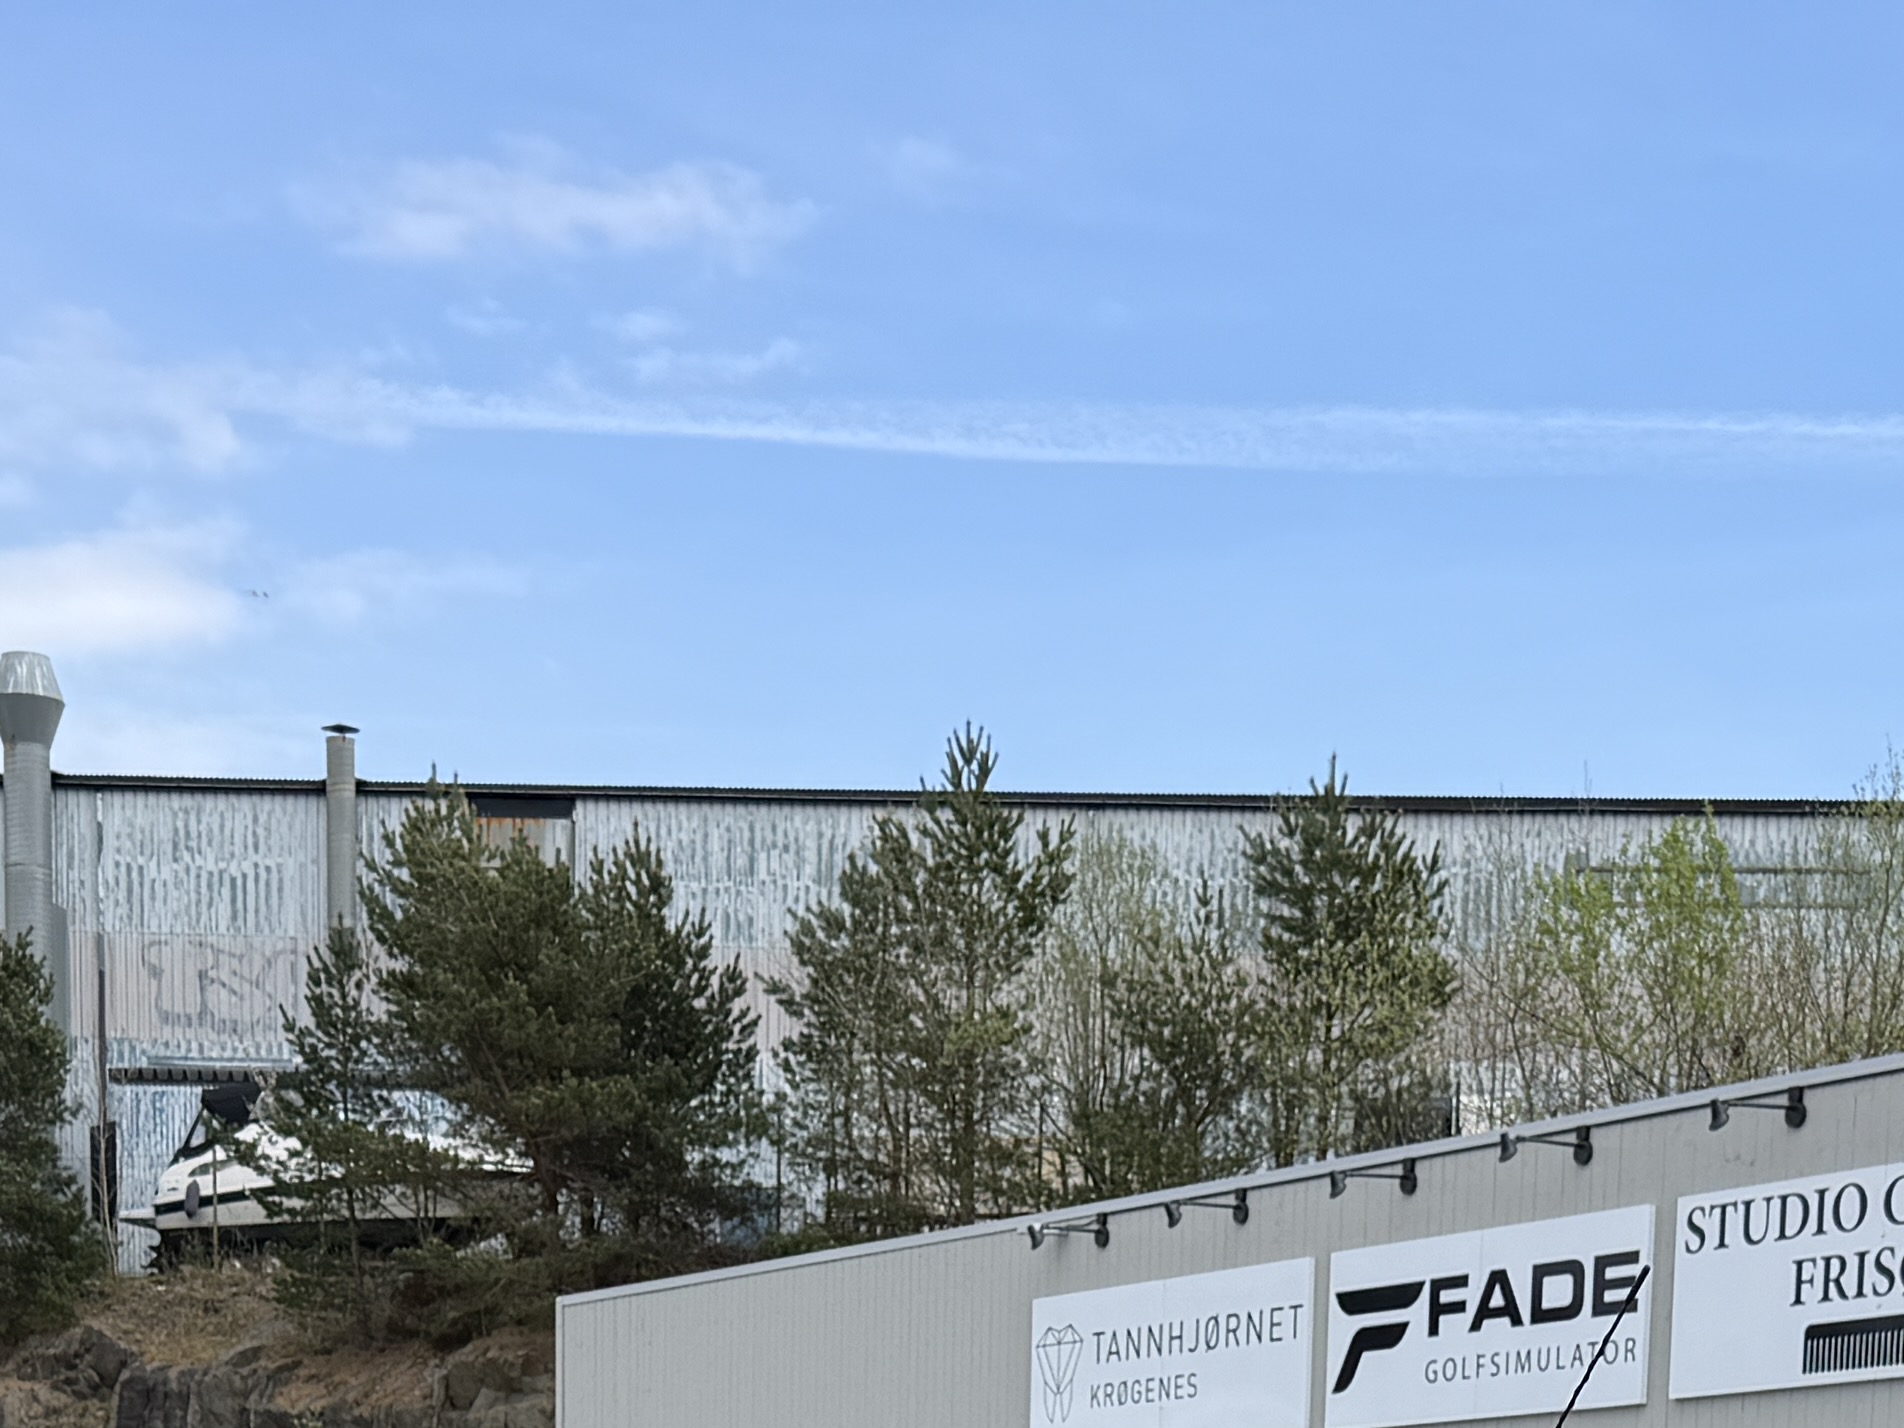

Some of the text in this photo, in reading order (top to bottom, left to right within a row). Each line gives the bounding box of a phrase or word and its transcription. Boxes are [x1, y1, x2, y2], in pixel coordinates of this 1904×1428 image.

[1685, 1183, 1868, 1255] STUDIO
[1428, 1250, 1641, 1337] FADE
[1092, 1303, 1304, 1365] TANNHJØRNET
[1424, 1337, 1637, 1384] GOLFSIMULATOR
[1090, 1373, 1198, 1409] KRØGENES
